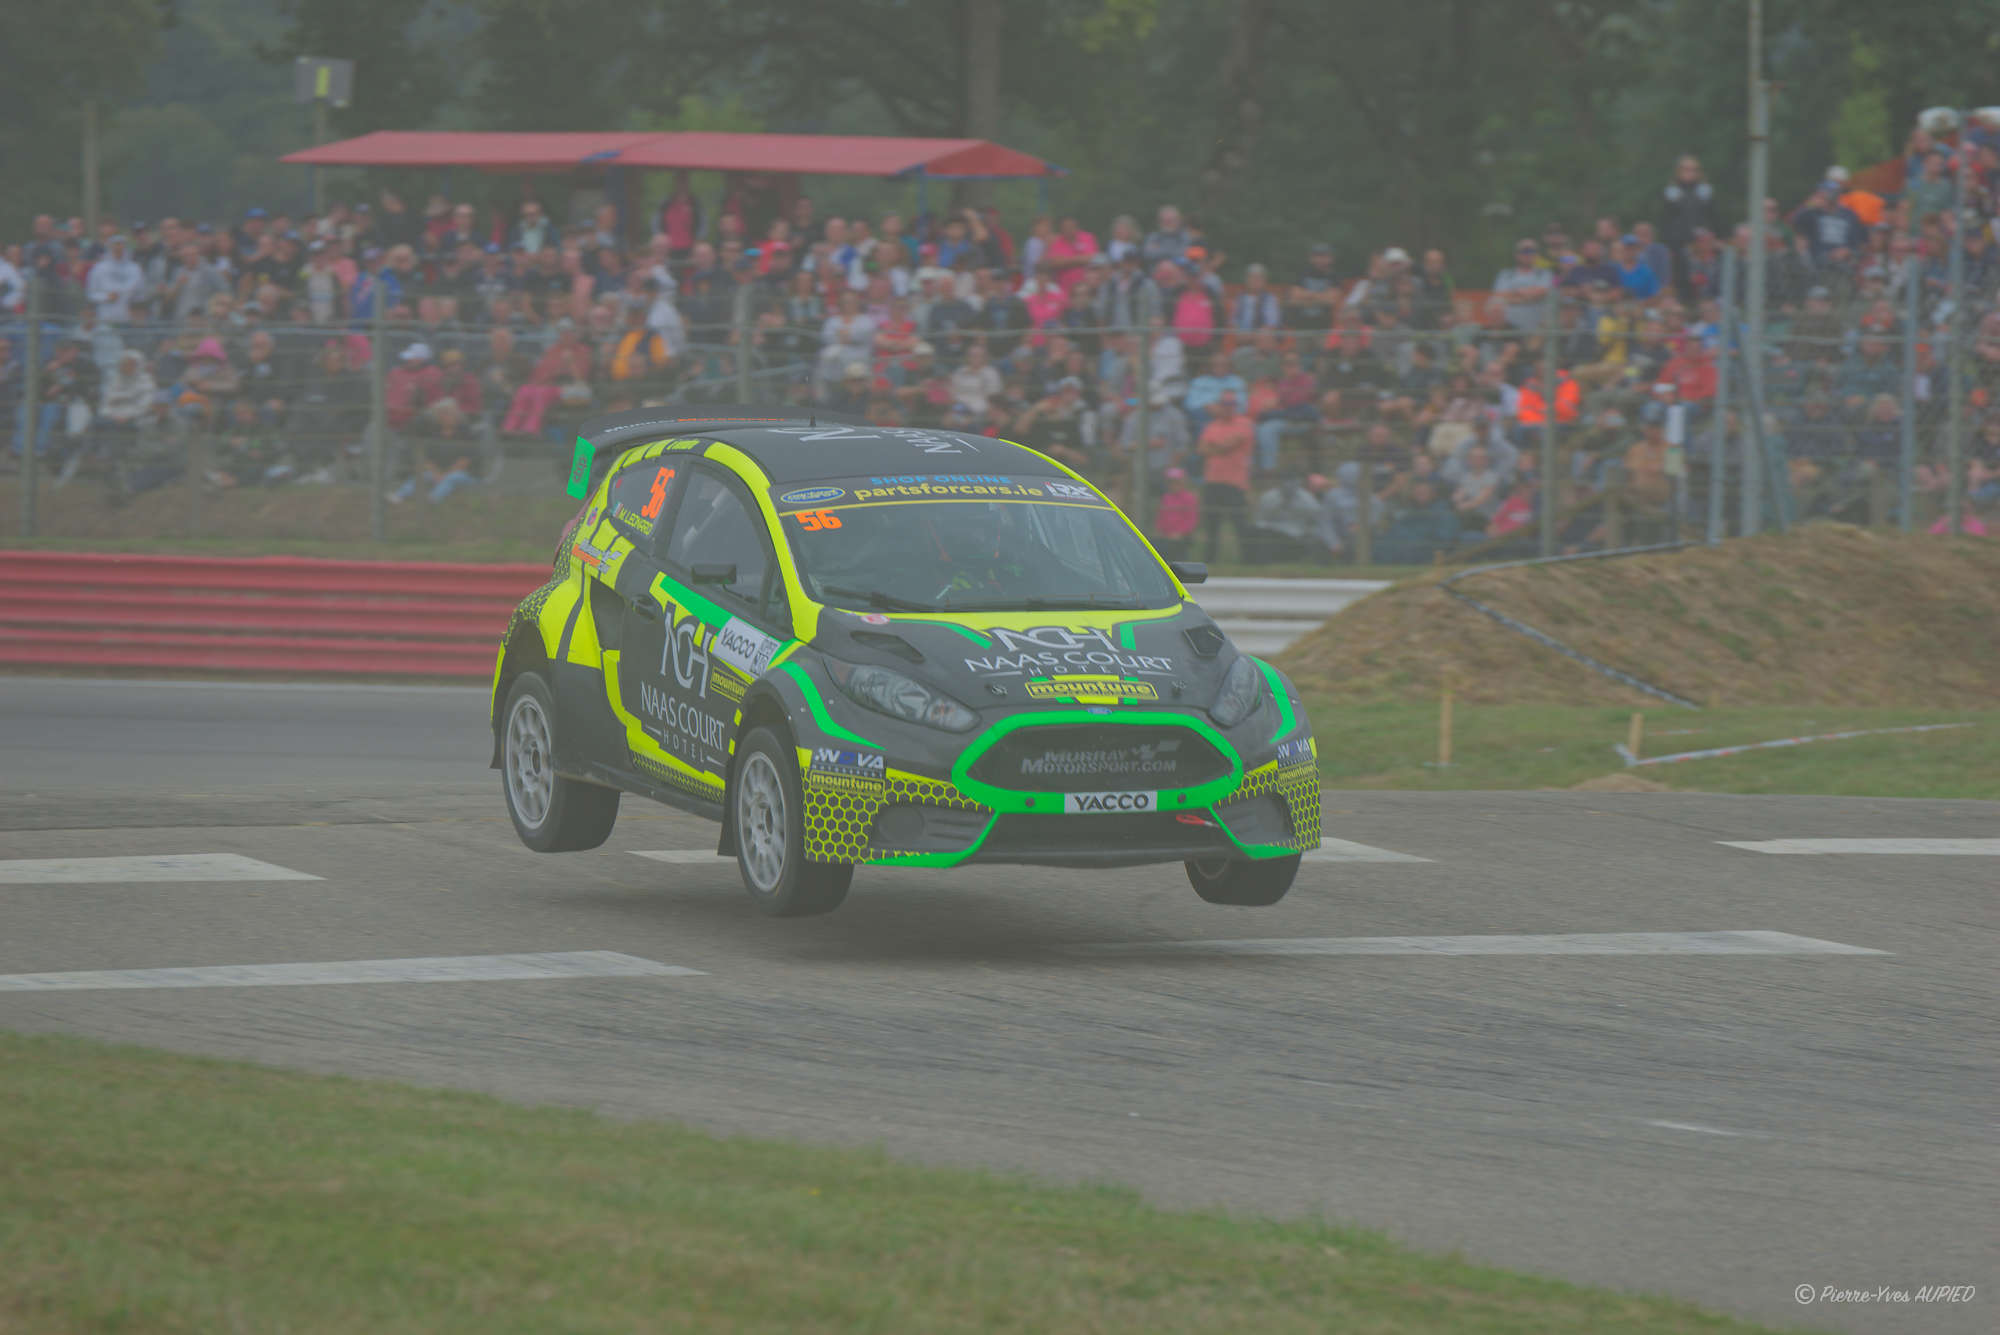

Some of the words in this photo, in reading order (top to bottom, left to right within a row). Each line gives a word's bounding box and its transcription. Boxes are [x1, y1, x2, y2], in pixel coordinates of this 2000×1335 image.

[869, 476, 929, 486] SHOP
[934, 475, 1014, 485] ONLINE
[641, 466, 676, 519] 56
[854, 483, 1043, 501] partsforcars.ie
[794, 510, 843, 531] 56
[721, 628, 756, 658] YACCO
[964, 652, 1060, 673] NAAS
[1064, 651, 1173, 671] COURT
[1029, 666, 1133, 676] HOTEL
[712, 672, 748, 697] mountun
[1031, 682, 1152, 696] mountune
[641, 681, 677, 728] NAAS
[678, 703, 725, 752] COURT
[664, 729, 705, 763] HOTEL
[1044, 750, 1129, 763] MURRAY
[1021, 758, 1177, 774] MOTORSPORT.COM
[812, 774, 882, 792] mountune
[1074, 794, 1149, 811] YACCO
